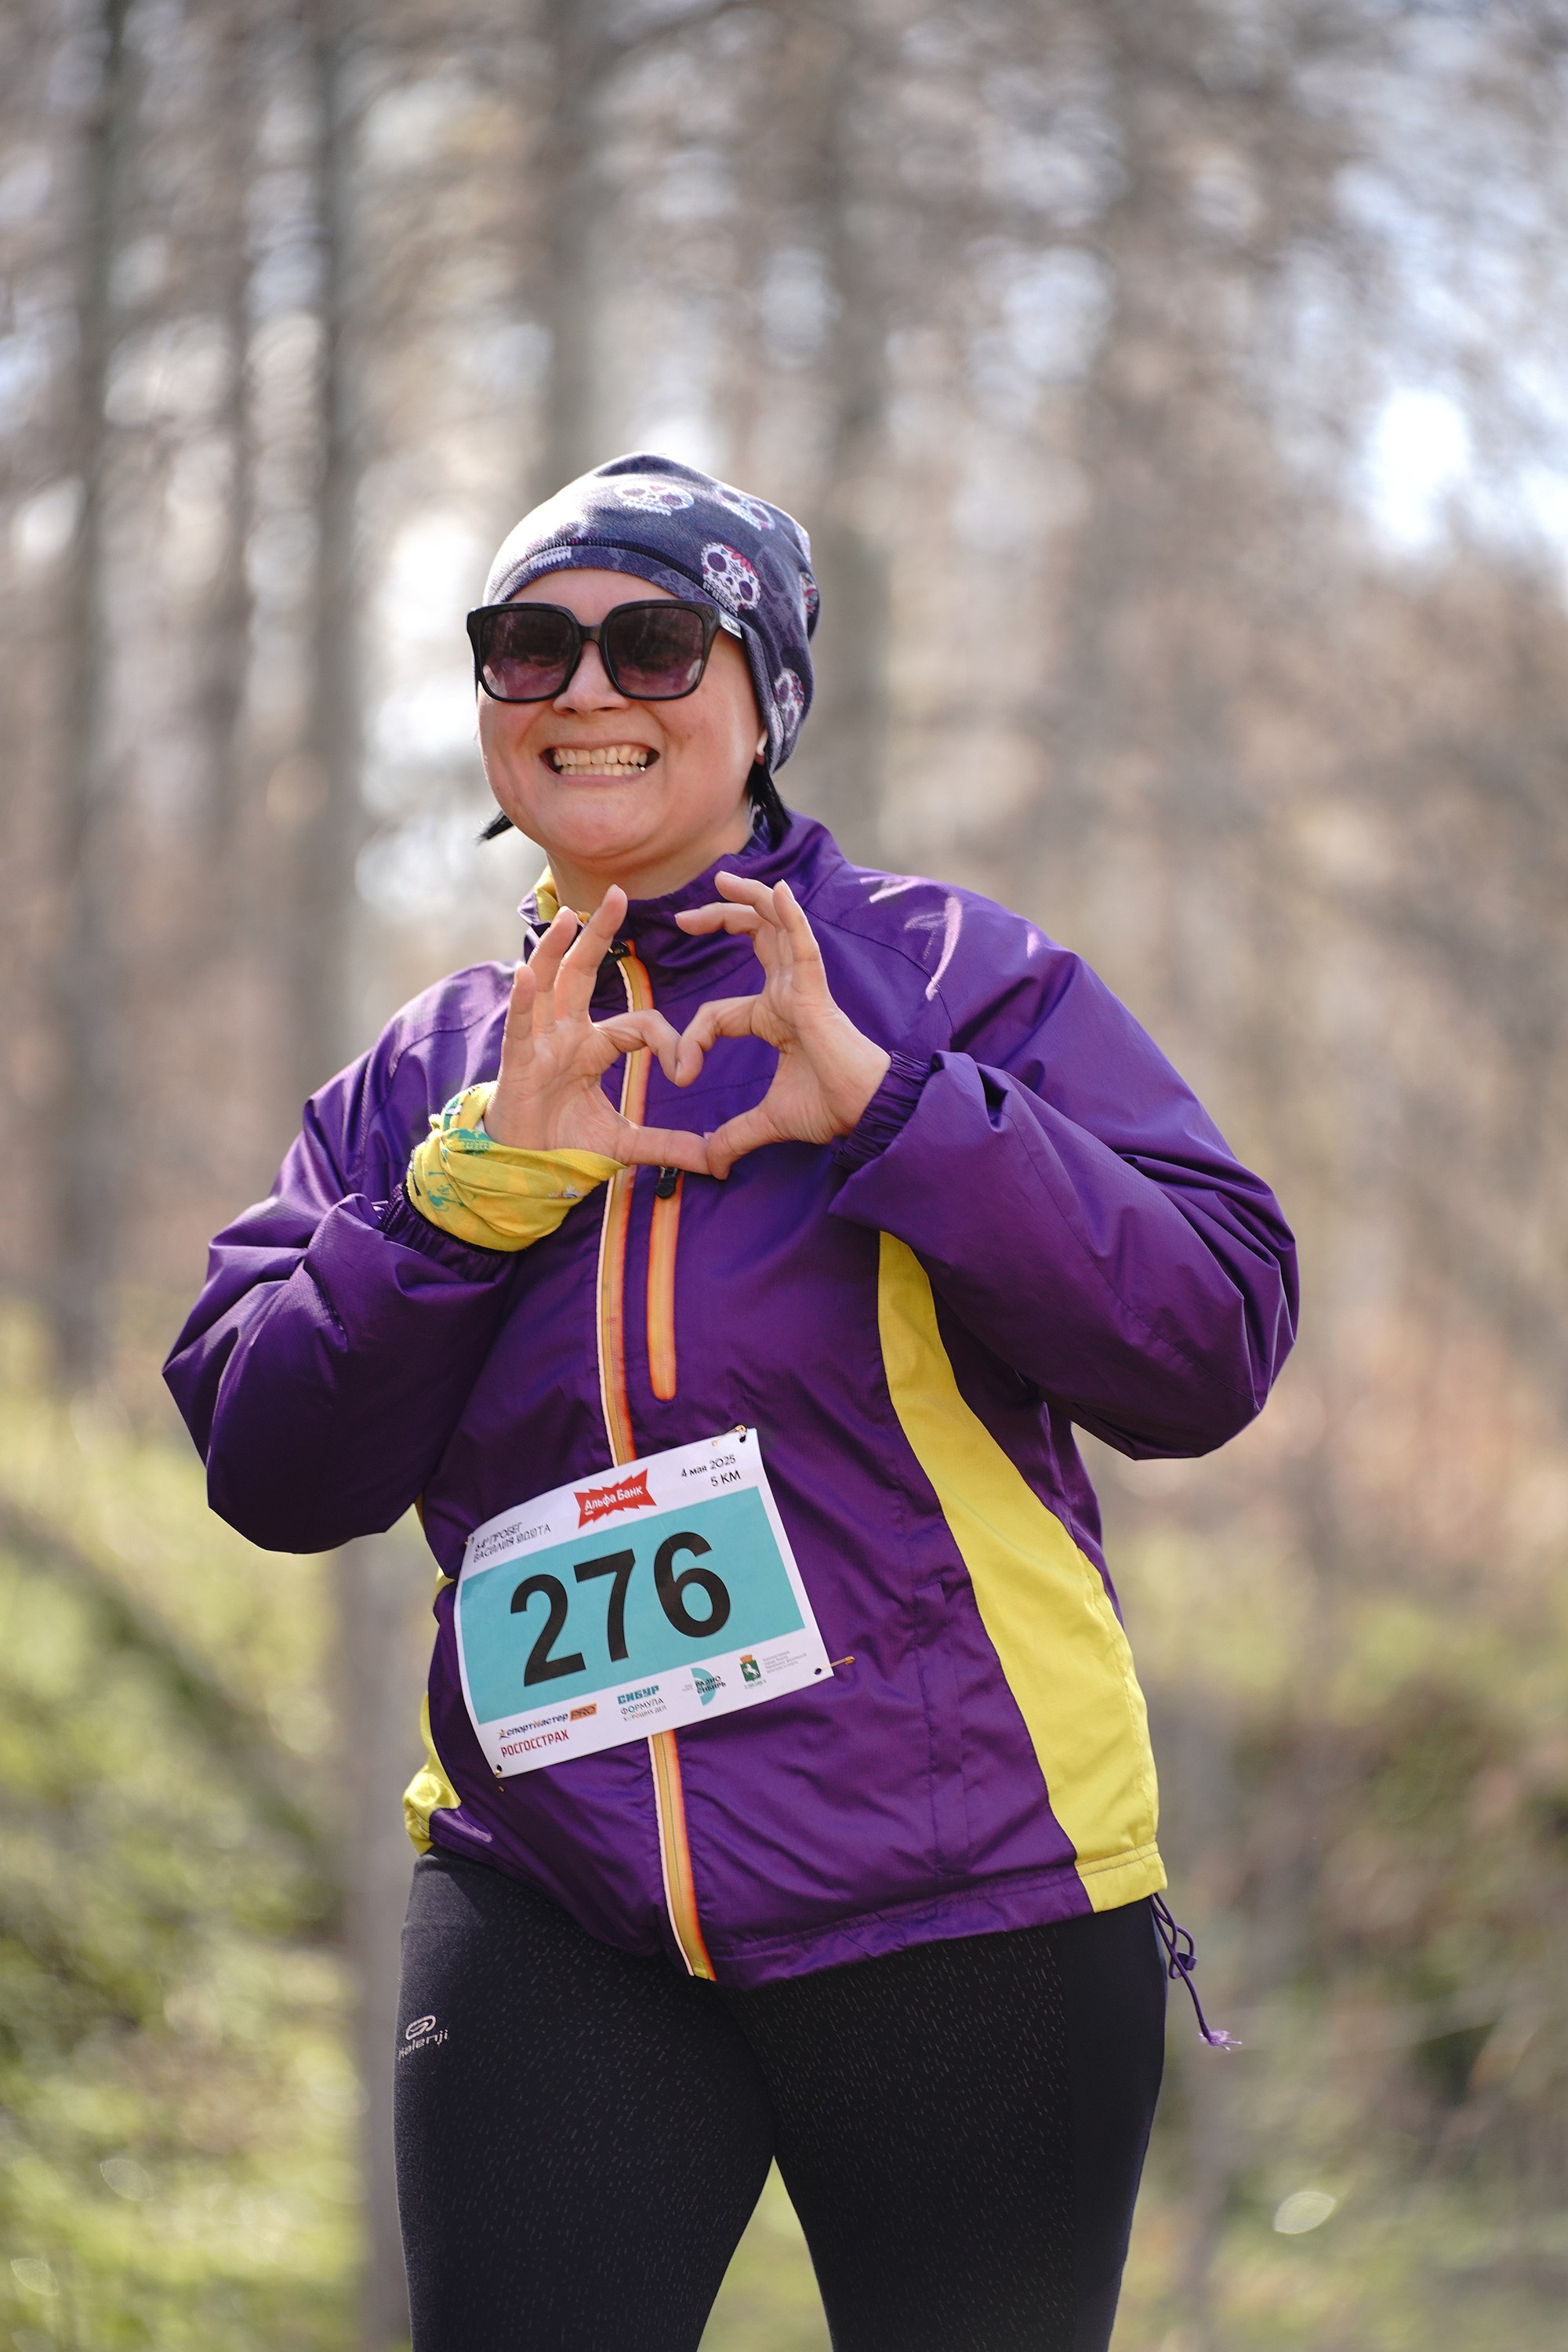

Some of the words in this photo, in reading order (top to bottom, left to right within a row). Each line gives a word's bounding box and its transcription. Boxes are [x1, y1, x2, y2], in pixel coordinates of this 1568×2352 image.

[681, 1467, 688, 1478] 4
[689, 1465, 707, 1475] мая
[710, 1454, 736, 1470] 2025
[710, 1475, 718, 1487] 5
[720, 1469, 742, 1485] КМ
[584, 1494, 617, 1515] Альфа
[616, 1486, 644, 1501] Банк
[510, 1532, 731, 1687] 276
[617, 1685, 659, 1705] СИБУР
[620, 1697, 664, 1715] ФОРМУЛА
[500, 1729, 570, 1758] РОСГОССТРАХ
